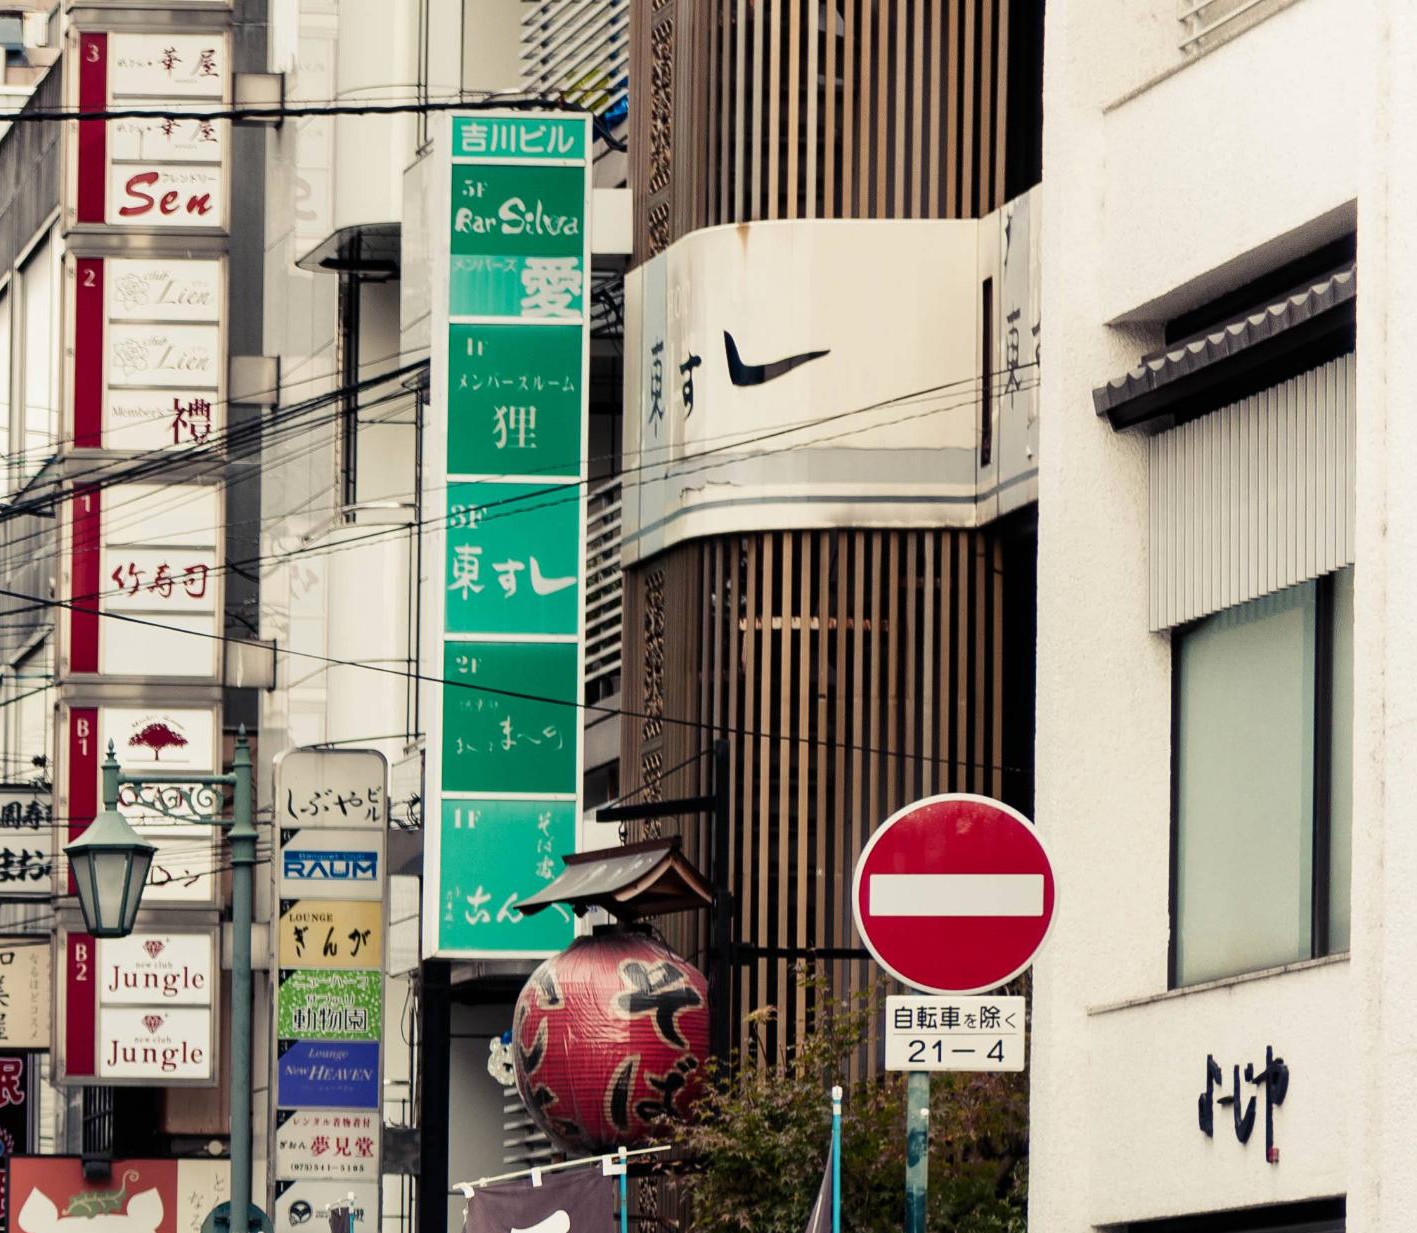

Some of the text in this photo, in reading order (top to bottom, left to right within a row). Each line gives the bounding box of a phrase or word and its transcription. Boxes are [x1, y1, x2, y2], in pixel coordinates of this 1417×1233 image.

[87, 44, 99, 62] 3
[461, 124, 573, 154] 吉川ビル
[119, 171, 212, 216] Sen
[455, 208, 497, 233] Bar
[84, 269, 96, 287] 2
[521, 256, 582, 318] 愛
[458, 373, 575, 393] メンバーズルーム
[493, 405, 538, 449] 狸
[447, 542, 577, 600] 東すし
[287, 787, 363, 820] しぶや
[284, 861, 377, 878] RAUM
[289, 913, 334, 923] LOUNGE
[293, 926, 371, 957] ぎんが
[109, 965, 205, 998] Jungle
[894, 1005, 1017, 1030] 自転車を除く
[107, 1040, 203, 1072] Jungle
